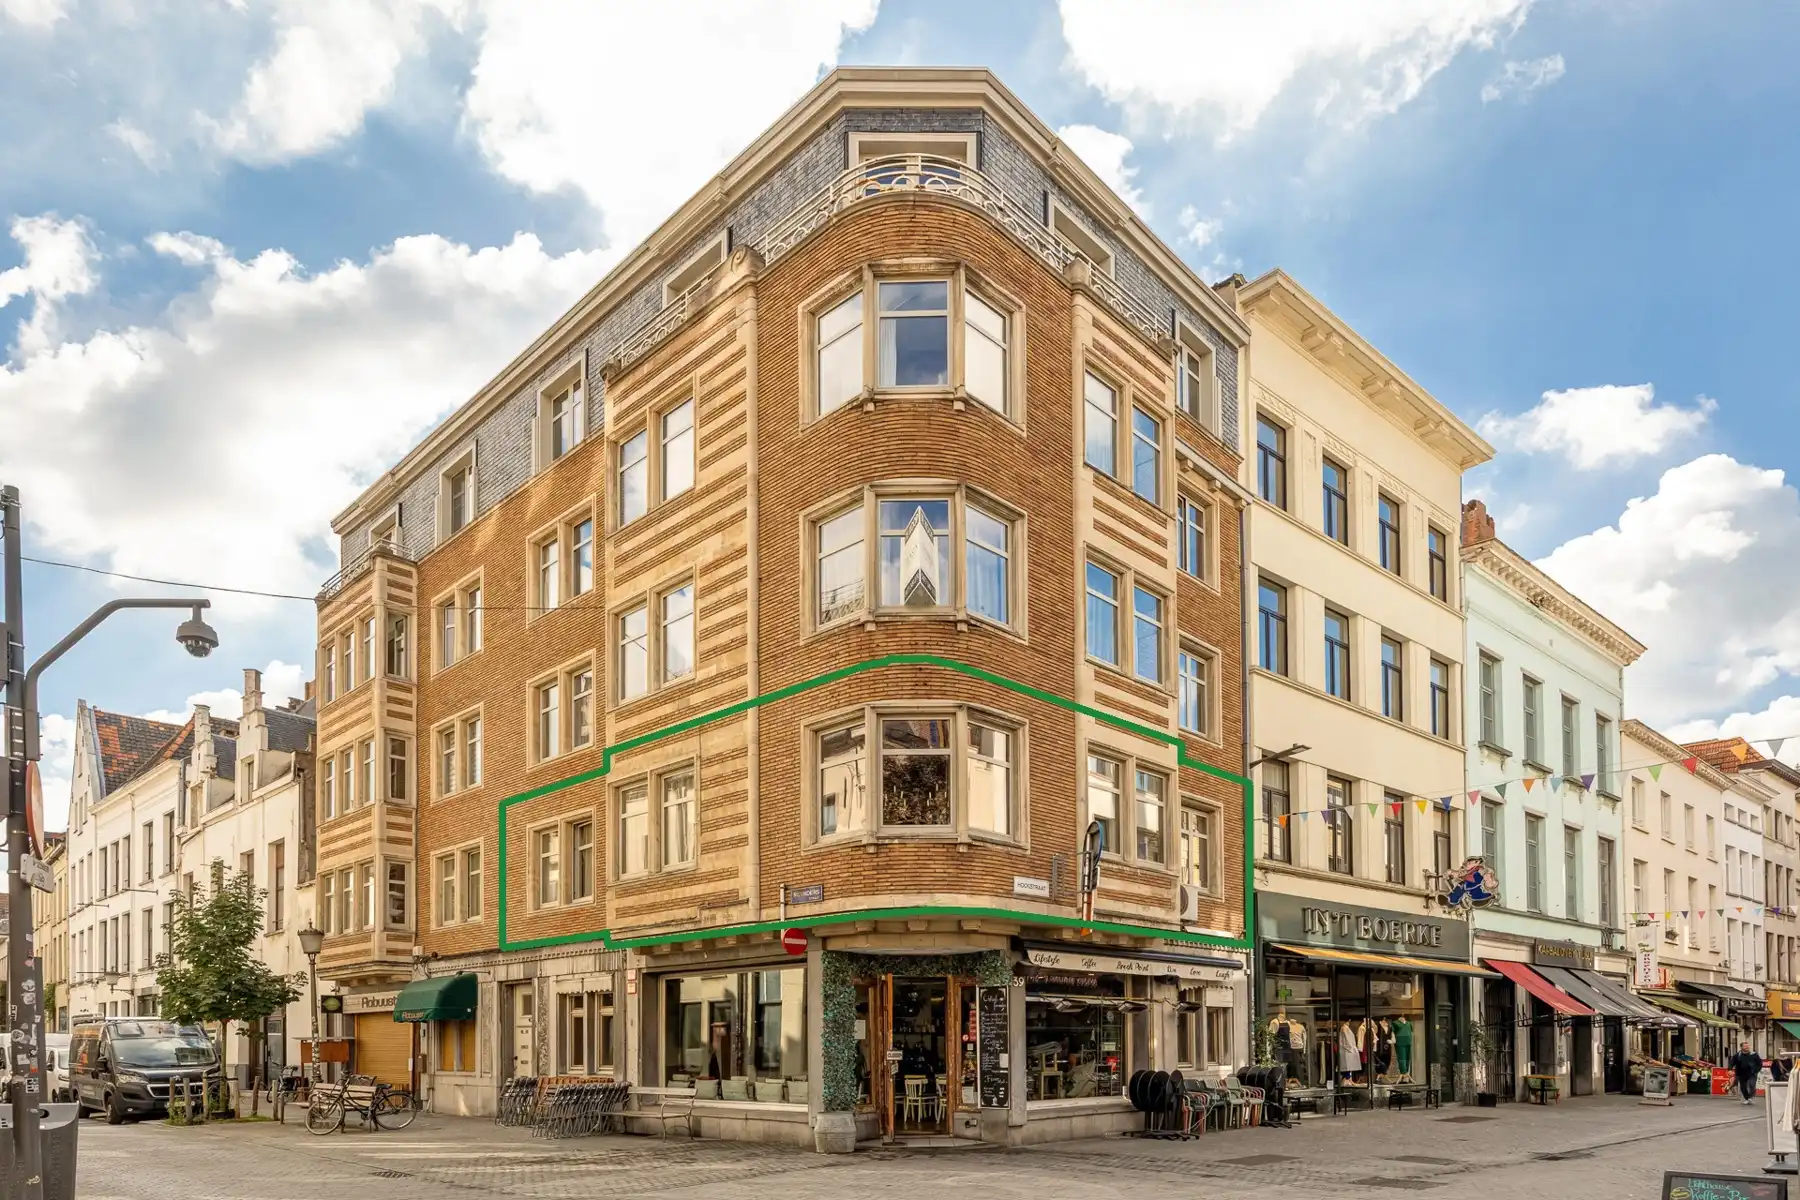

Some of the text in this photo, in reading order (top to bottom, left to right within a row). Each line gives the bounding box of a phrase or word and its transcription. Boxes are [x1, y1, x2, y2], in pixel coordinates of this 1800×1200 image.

[1356, 915, 1442, 947] BOERKE
[1033, 953, 1060, 966] Lifestyle
[1013, 976, 1025, 987] 39
[361, 996, 397, 1008] Robuust
